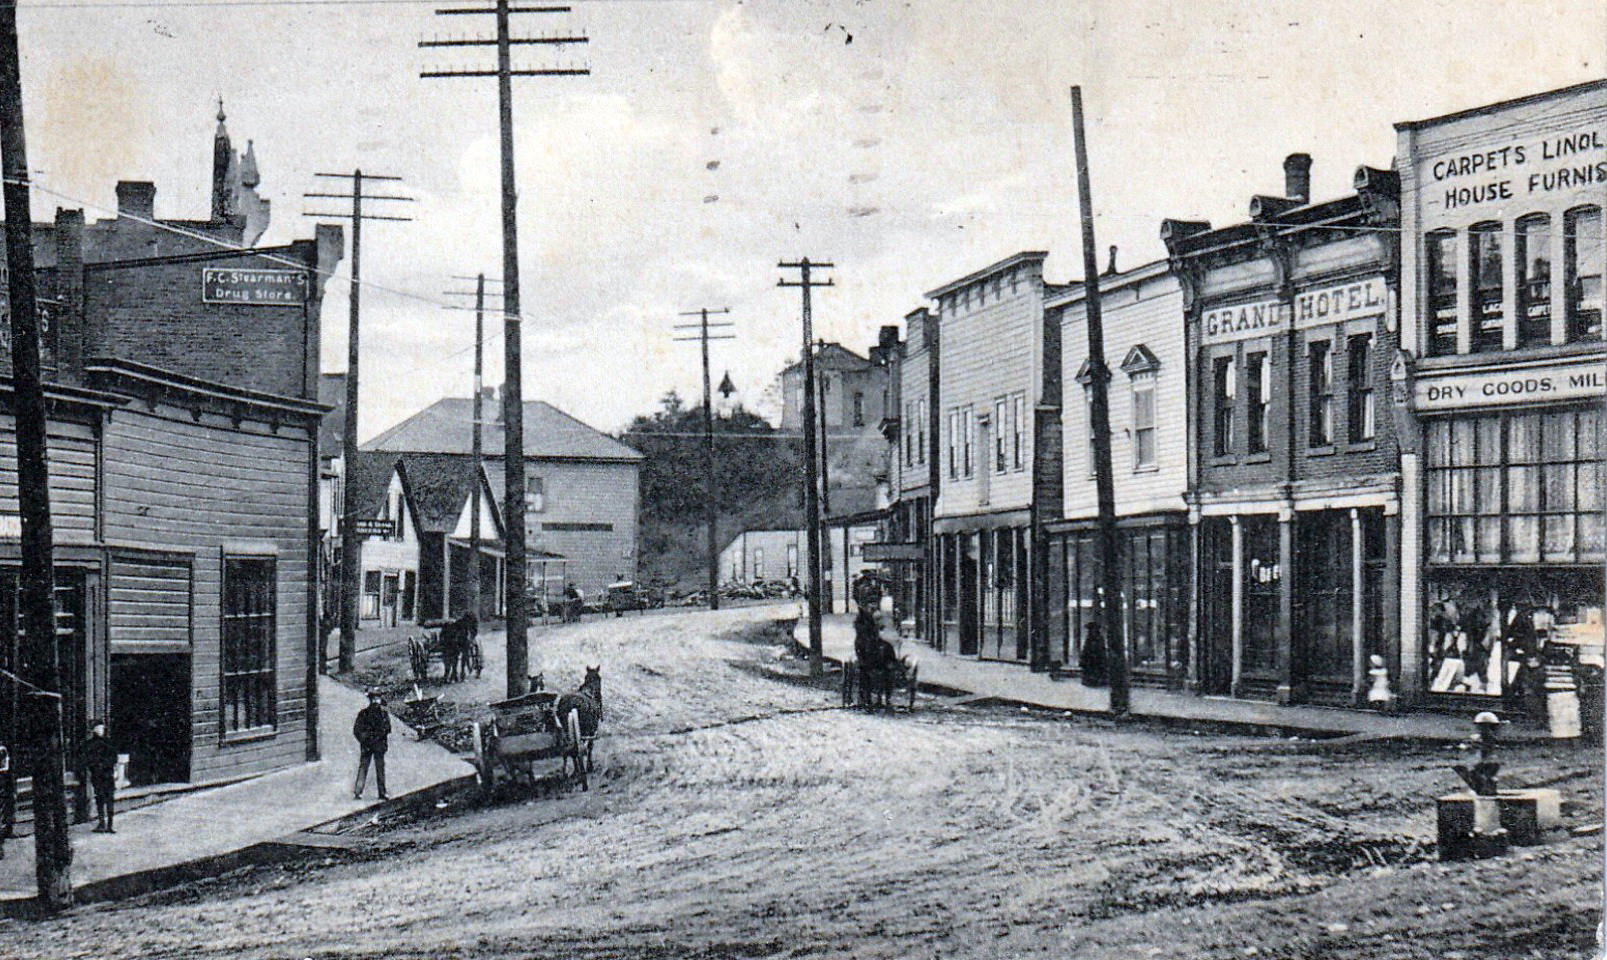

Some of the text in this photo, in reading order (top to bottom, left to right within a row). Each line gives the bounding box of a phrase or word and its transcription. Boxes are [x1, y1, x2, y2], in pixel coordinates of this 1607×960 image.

[1433, 131, 1604, 181] CARPETS LINOL
[1445, 161, 1607, 209] HOUSE FURNIS
[215, 288, 249, 301] Drug
[1207, 302, 1284, 336] GRAND
[1428, 385, 1467, 401] DRY
[1569, 372, 1604, 389] MIL
